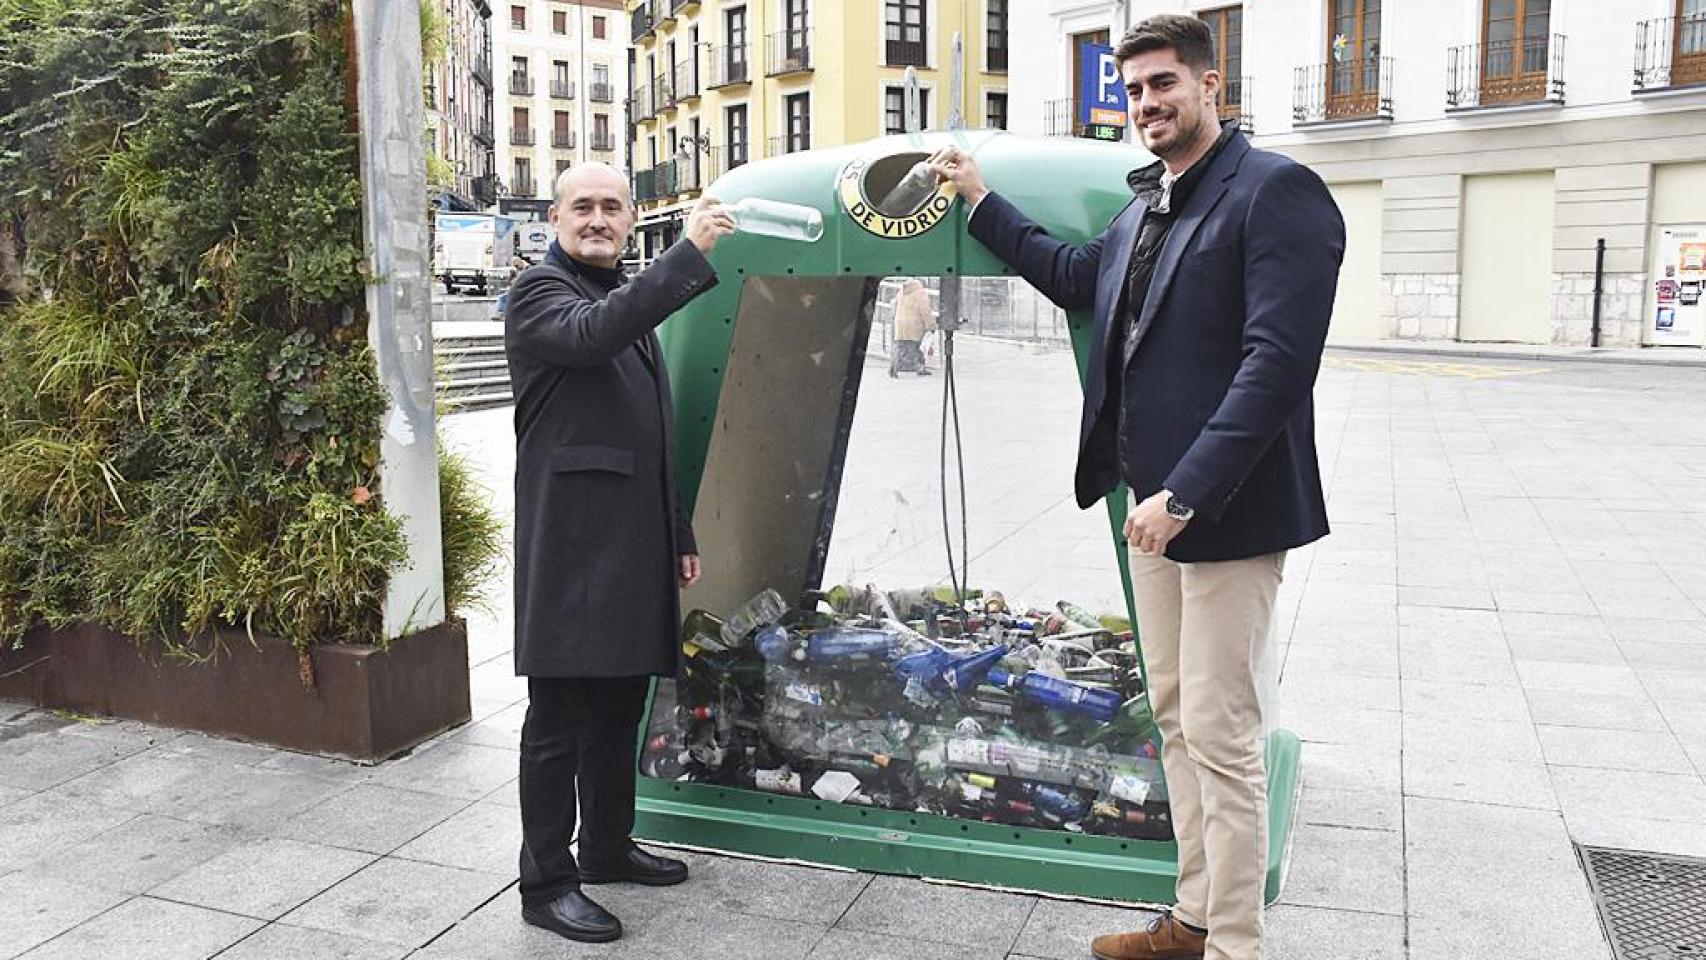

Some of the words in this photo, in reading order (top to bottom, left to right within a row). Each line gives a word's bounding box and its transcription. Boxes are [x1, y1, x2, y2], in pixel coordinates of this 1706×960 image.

[1099, 53, 1120, 103] P
[851, 201, 876, 228] DE
[882, 196, 949, 236] VIDRIO
